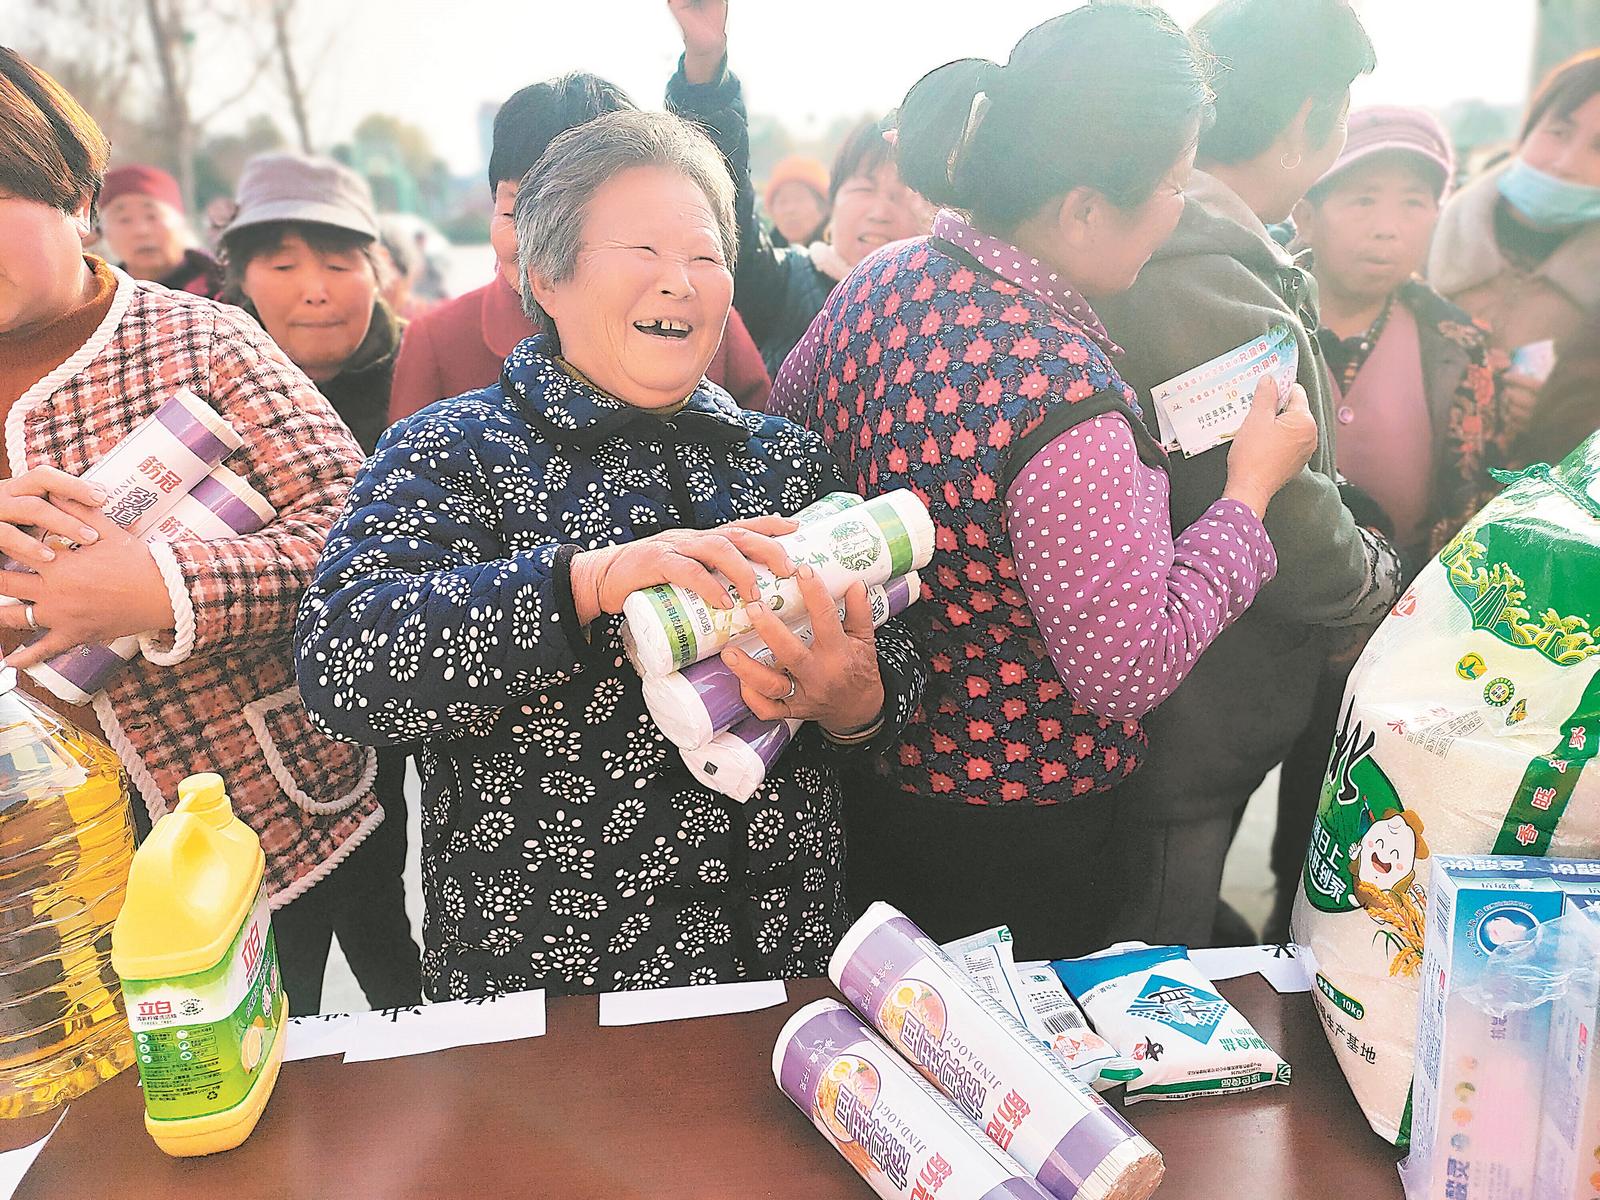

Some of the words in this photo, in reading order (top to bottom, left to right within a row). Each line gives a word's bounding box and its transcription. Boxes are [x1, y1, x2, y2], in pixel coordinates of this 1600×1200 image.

[1197, 402, 1234, 425] 村庄是我家
[1226, 389, 1238, 401] 10
[136, 455, 183, 495] 筋冠
[1309, 844, 1347, 903] 旺到家
[241, 921, 261, 977] 立白
[137, 1000, 172, 1016] 立白
[899, 1010, 987, 1120] 劲道挂面
[834, 1083, 912, 1191] 劲道挂面
[984, 1087, 1032, 1152] 筋冠
